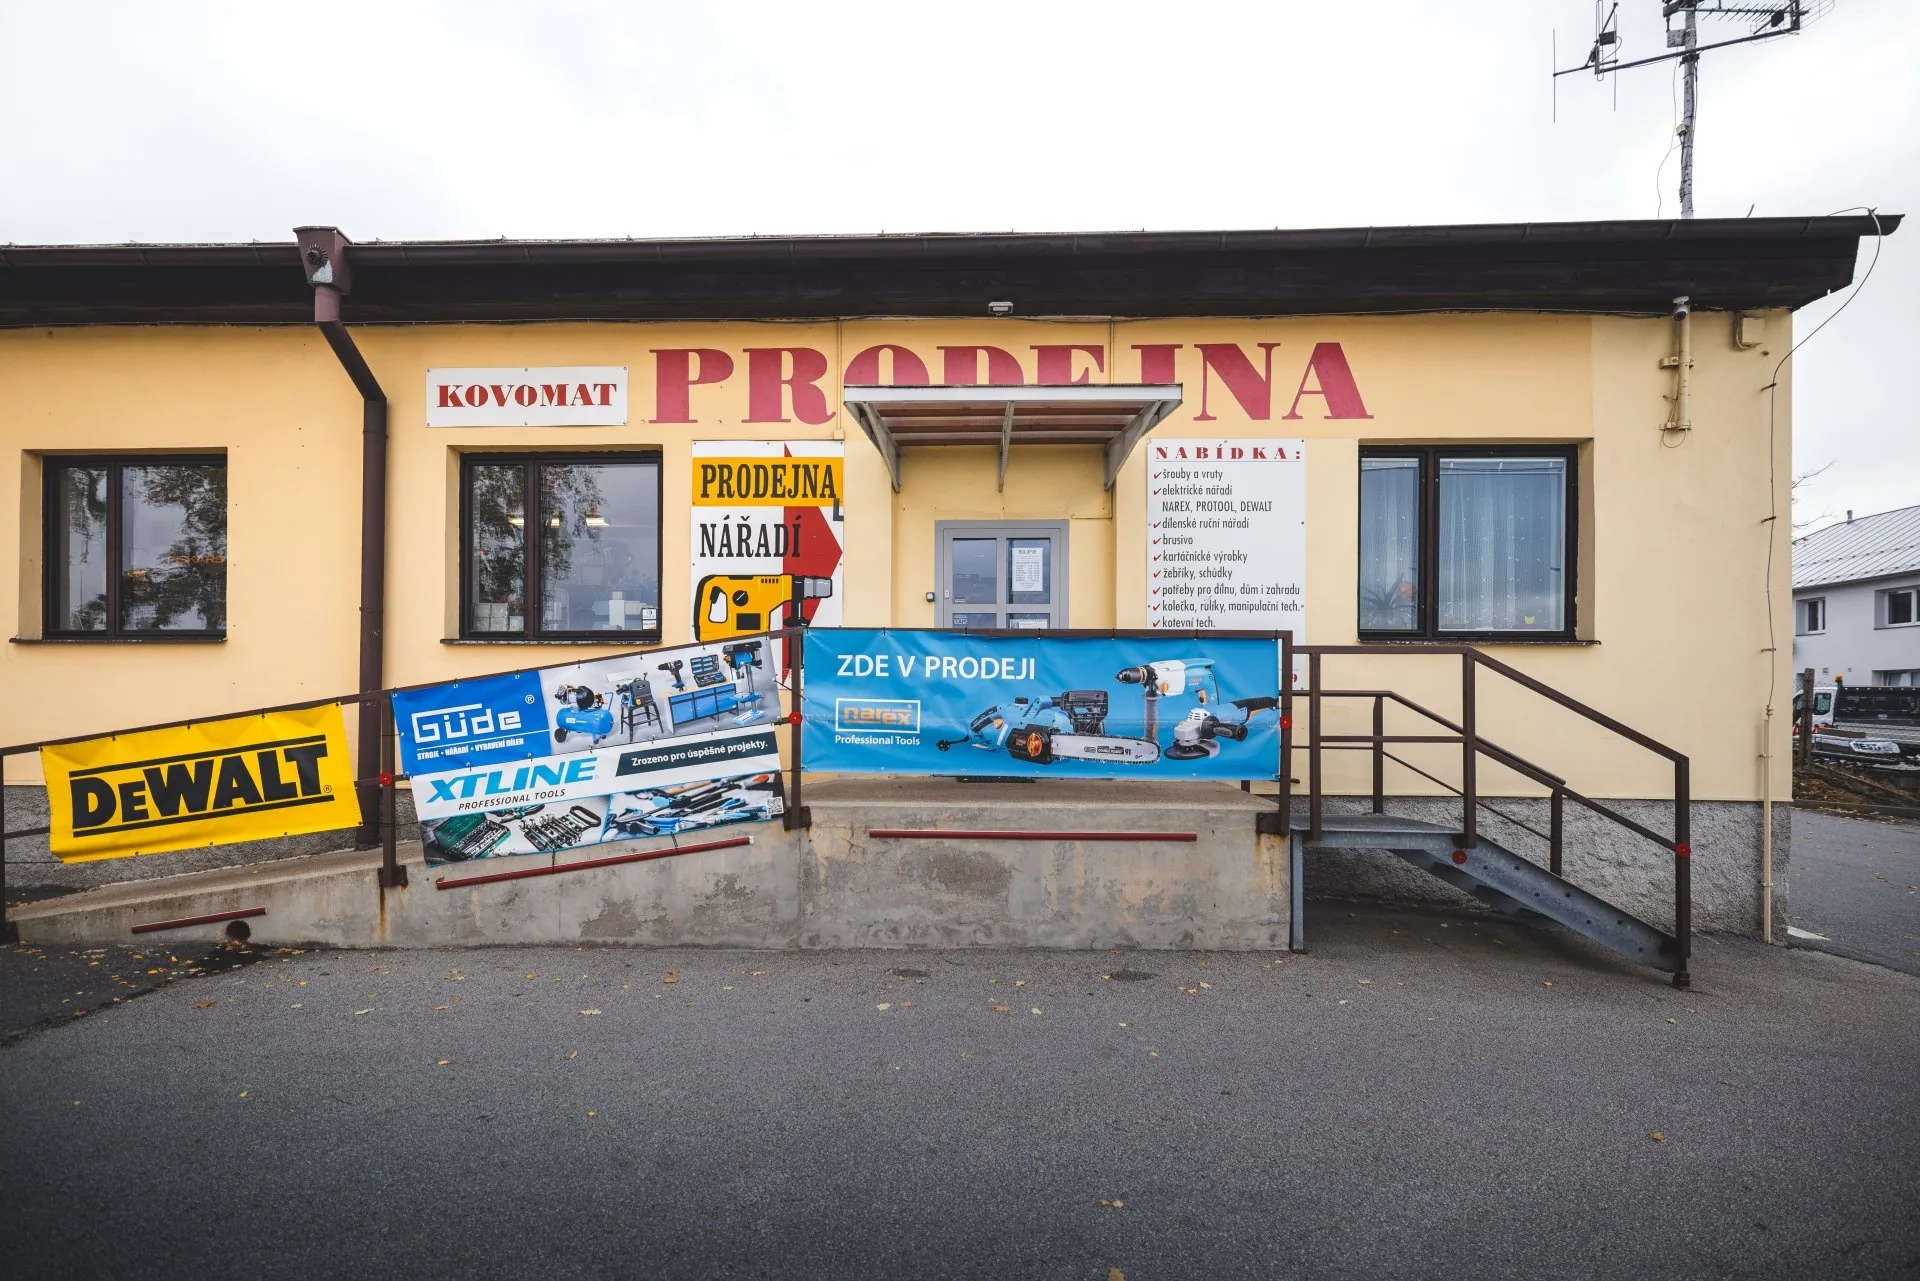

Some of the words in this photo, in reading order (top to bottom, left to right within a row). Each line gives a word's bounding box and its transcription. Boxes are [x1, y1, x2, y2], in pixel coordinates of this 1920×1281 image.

[437, 383, 617, 408] KOVOMAT
[700, 463, 837, 499] PRODEJNA
[1162, 467, 1191, 481] šrouby
[1194, 471, 1199, 479] a
[1202, 470, 1223, 481] vruty
[1162, 484, 1203, 495] elektrické
[1206, 484, 1233, 495] nářadí
[1162, 501, 1193, 513] NAREX,
[1196, 501, 1238, 513] PROTOOL,
[1240, 501, 1272, 512] DEWALT
[1162, 517, 1197, 529] dílenské
[1199, 517, 1220, 529] ruční
[1222, 517, 1250, 529] nářadí
[699, 514, 802, 558] NÁŘADÍ
[1162, 533, 1194, 545] brusivo
[1163, 550, 1211, 562] kartáčnické
[1213, 550, 1248, 564] výrobky
[1163, 566, 1196, 580] žebříky,
[1162, 583, 1195, 597] potřeby
[1197, 586, 1211, 597] pro
[1214, 583, 1237, 597] dílnu,
[1266, 582, 1300, 595] zahradu
[1162, 600, 1197, 613] kolečka,
[1228, 600, 1279, 614] manipulační
[1281, 600, 1301, 611] tech.
[1162, 616, 1194, 628] kotevní
[1196, 616, 1216, 628] tech.
[836, 654, 889, 677] ZDE
[897, 655, 916, 678] V
[924, 655, 1036, 680] PRODEJI
[843, 705, 913, 726] narex
[411, 703, 522, 744] Güde
[835, 735, 894, 746] Professional
[894, 736, 921, 746] Tools
[416, 751, 440, 760] STROJE
[445, 745, 469, 756] NÁŘADÍ
[475, 740, 506, 752] VYBAVENÍ
[631, 754, 669, 767] Zrozeno
[670, 752, 686, 763] pro
[687, 745, 726, 759] úspěšné
[727, 740, 768, 756] projekty.
[426, 756, 598, 804] XTLINE
[458, 794, 531, 811] PROFESSIONAL
[534, 789, 566, 800] TOOLS
